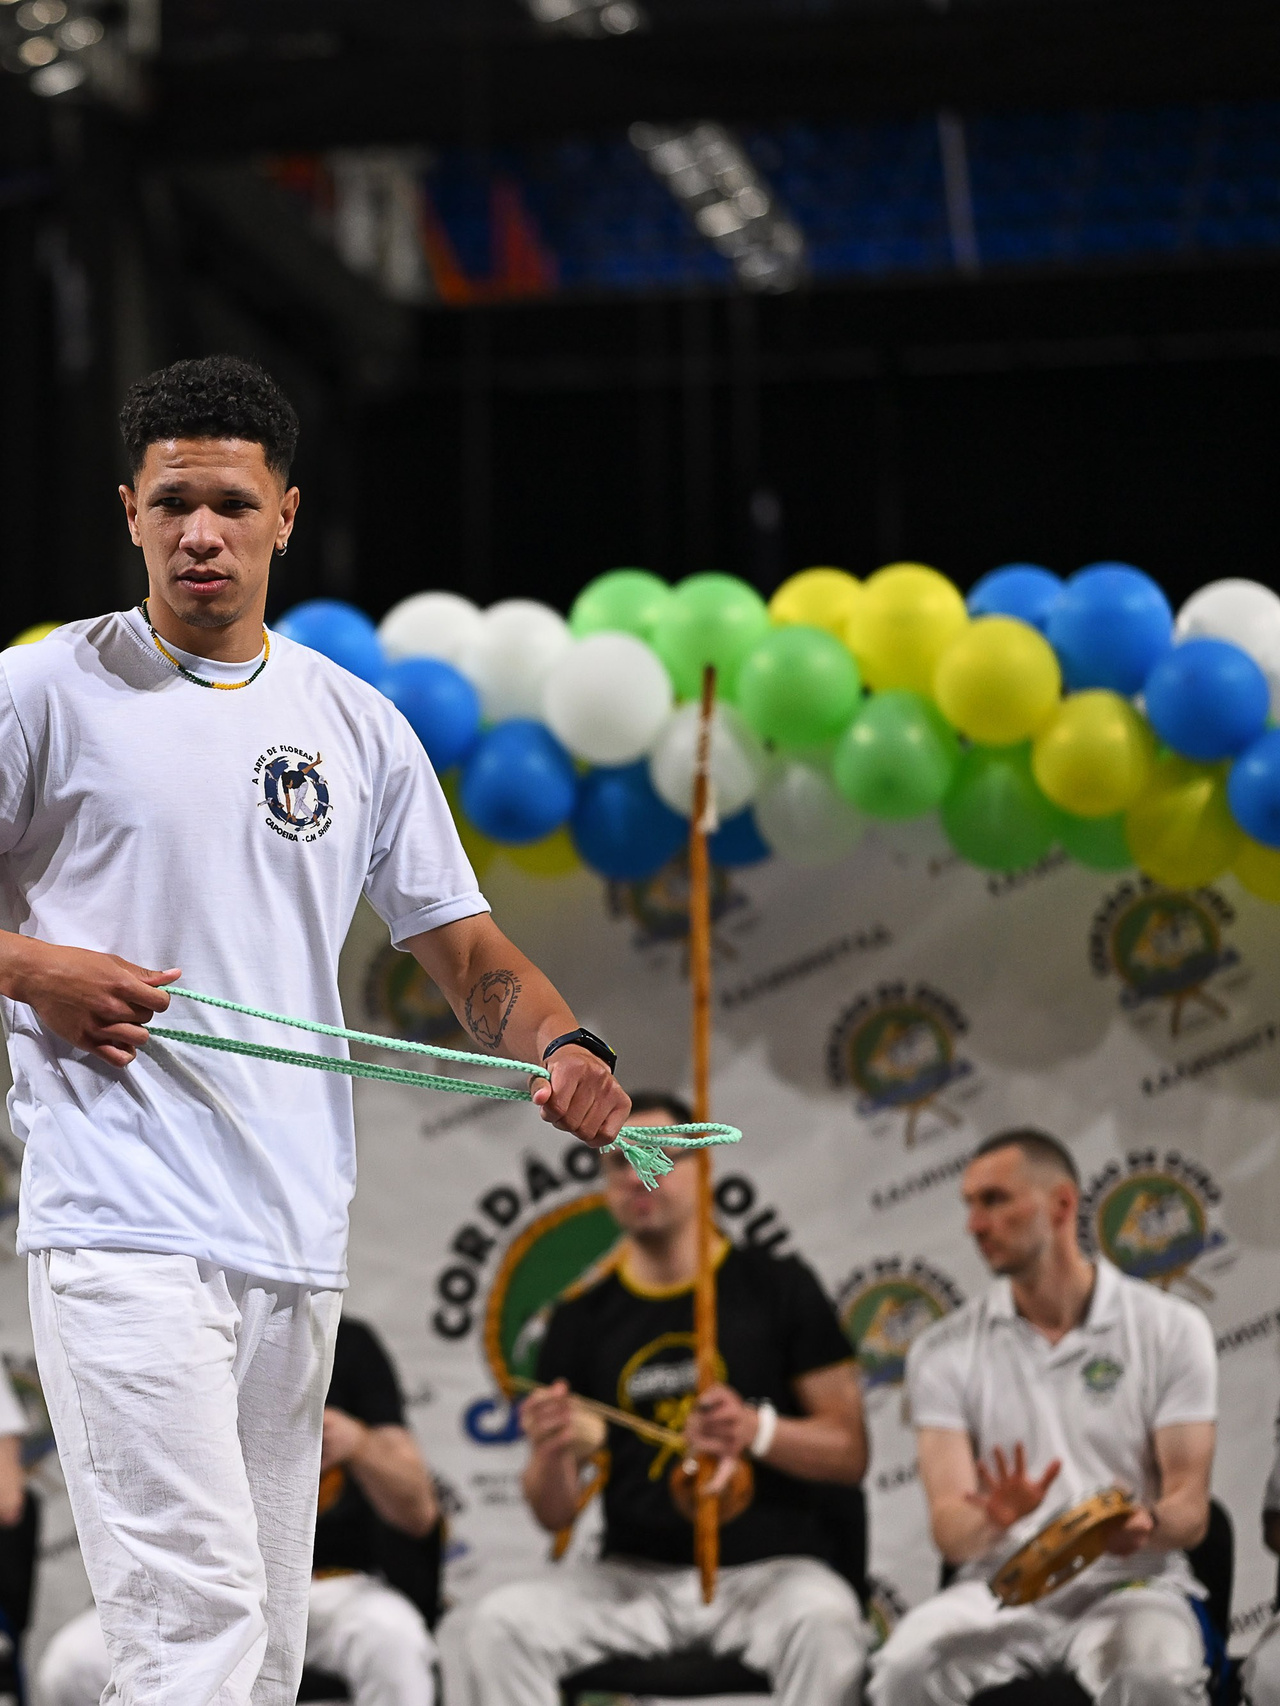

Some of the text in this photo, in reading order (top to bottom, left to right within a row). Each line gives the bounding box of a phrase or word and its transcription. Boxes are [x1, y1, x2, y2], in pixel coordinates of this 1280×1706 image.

[253, 754, 267, 774] ARTE
[266, 746, 277, 756] DE
[279, 745, 314, 762] FLOREAR
[265, 817, 299, 843] CAPOEIRA
